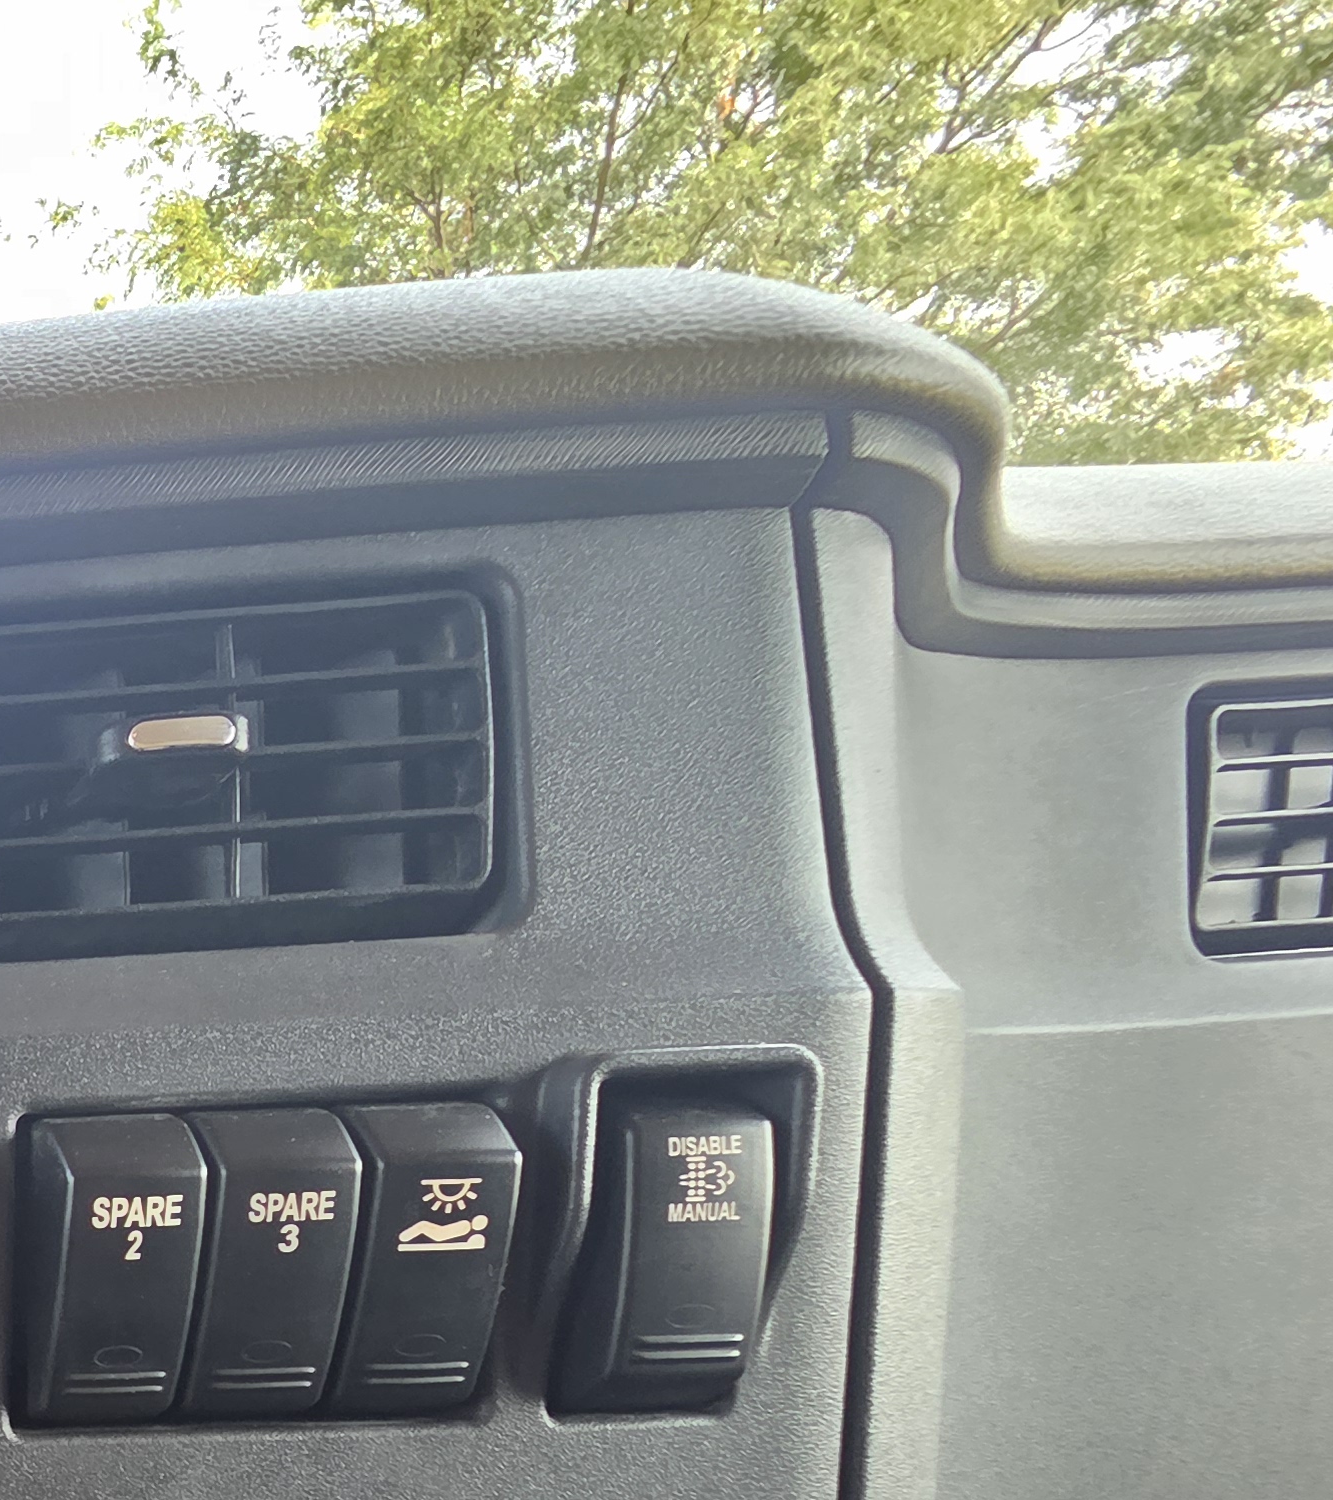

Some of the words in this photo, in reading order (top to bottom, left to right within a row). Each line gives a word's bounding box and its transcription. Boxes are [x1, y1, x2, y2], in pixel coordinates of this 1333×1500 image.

[667, 1134, 743, 1157] DISABLE
[91, 1194, 183, 1229] SPARE
[248, 1190, 337, 1223] SPARE
[667, 1201, 741, 1222] MANUAL
[124, 1230, 143, 1260] 2
[278, 1223, 300, 1253] 3
